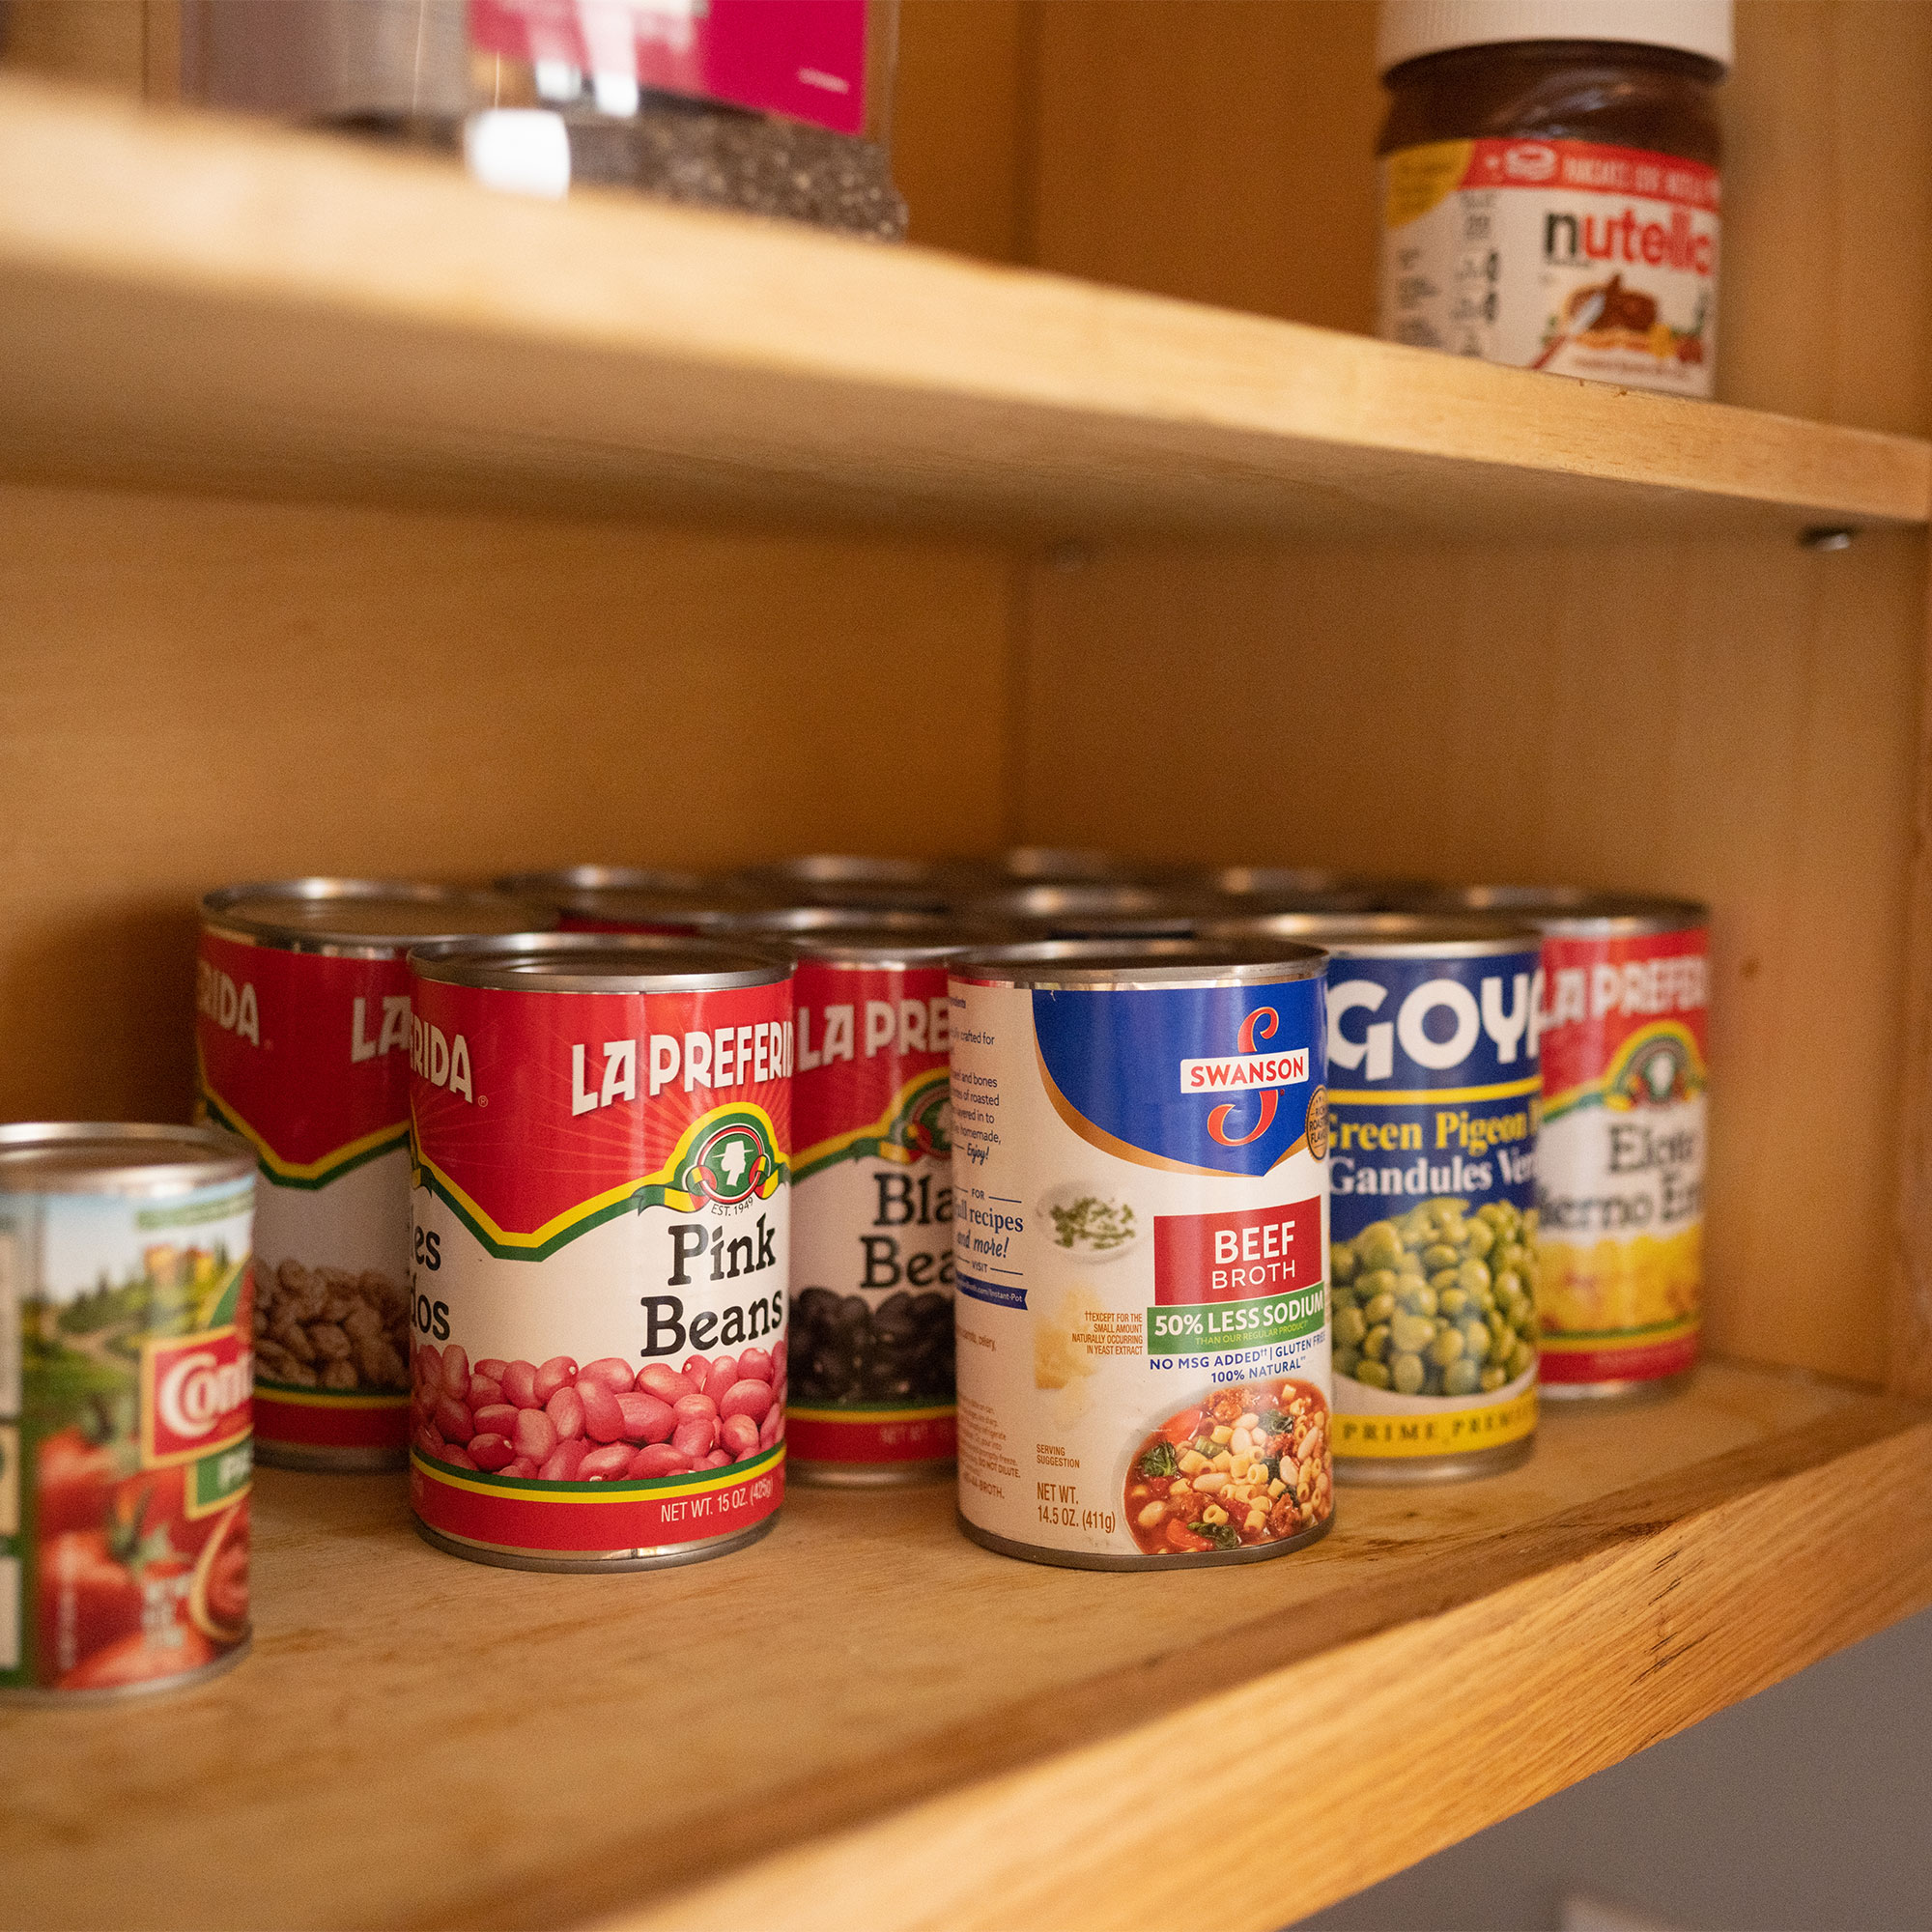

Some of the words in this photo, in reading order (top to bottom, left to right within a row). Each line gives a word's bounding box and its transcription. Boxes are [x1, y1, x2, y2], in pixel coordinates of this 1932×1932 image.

[352, 995, 412, 1063] LA
[798, 1004, 855, 1072] LA
[982, 1032, 995, 1045] for
[572, 1039, 636, 1117] LA
[974, 1072, 998, 1088] bones
[1190, 1056, 1304, 1089] SWANSON
[971, 1094, 1000, 1107] roasted
[985, 1112, 995, 1123] to
[967, 1142, 990, 1166] Enjoy!
[1329, 1154, 1492, 1195] Gandules
[971, 1188, 985, 1200] FOR
[711, 1202, 731, 1217] EST.
[734, 1196, 753, 1215] 1949
[970, 1208, 1024, 1235] recipes
[668, 1212, 777, 1287] Pink
[973, 1236, 1009, 1259] more!
[1214, 1220, 1295, 1264] BEEF
[971, 1260, 988, 1273] VISIT
[1212, 1259, 1295, 1290] BROTH
[640, 1290, 783, 1357] Beans
[1117, 1313, 1129, 1322] FOR
[1131, 1313, 1143, 1322] THE
[1154, 1313, 1204, 1337] 50%
[1208, 1307, 1260, 1334] LESS
[1263, 1290, 1323, 1327] SODIUM
[1071, 1333, 1106, 1344] NATURALLY
[1107, 1334, 1144, 1345] OCCURRING
[1094, 1323, 1115, 1333] SMALL
[1116, 1323, 1143, 1334] AMOUNT
[1195, 1336, 1221, 1346] THAN
[1222, 1333, 1242, 1344] OUR
[1243, 1327, 1278, 1341] REGULAR
[1087, 1344, 1094, 1354] IN
[1094, 1345, 1114, 1355] YEAST
[1115, 1346, 1143, 1355] EXTRACT
[1150, 1358, 1174, 1371] NO
[1179, 1355, 1209, 1370] MSG
[1275, 1338, 1312, 1358] GLUTEN
[1211, 1368, 1245, 1383] 100%
[1037, 1443, 1065, 1456] SERVING
[998, 1463, 1021, 1479] DILUTE.
[1037, 1455, 1080, 1468] SUGGESTION
[1037, 1482, 1057, 1501] NET
[1059, 1484, 1079, 1504] WT.
[661, 1501, 688, 1522] NET
[691, 1497, 713, 1518] WT.
[717, 1493, 729, 1513] 15
[732, 1488, 748, 1509] OZ.
[1037, 1505, 1060, 1525] 14.5
[1063, 1507, 1079, 1527] OZ.
[1082, 1509, 1116, 1534] (411g)
